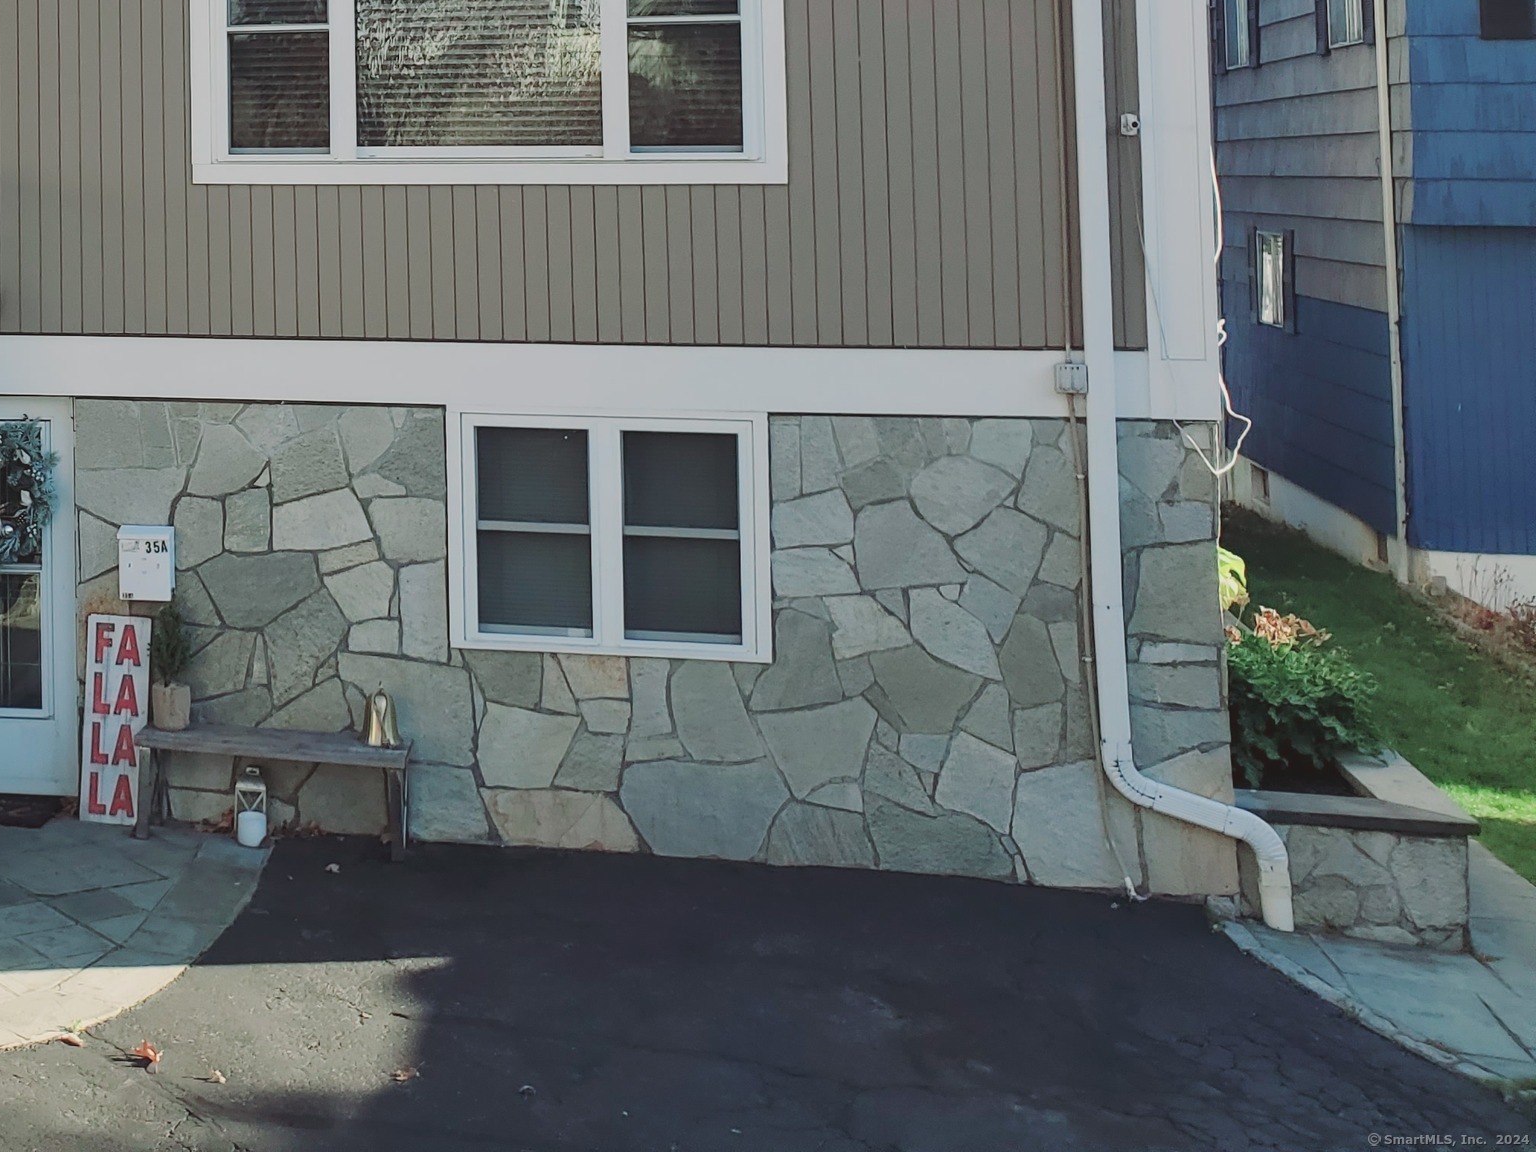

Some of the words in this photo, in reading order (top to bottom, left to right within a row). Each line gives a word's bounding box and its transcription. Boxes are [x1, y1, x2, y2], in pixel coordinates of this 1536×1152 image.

[145, 539, 168, 554] 35A
[95, 622, 141, 666] FA
[92, 672, 139, 717] LA
[90, 722, 137, 767] LA
[88, 771, 135, 817] LA
